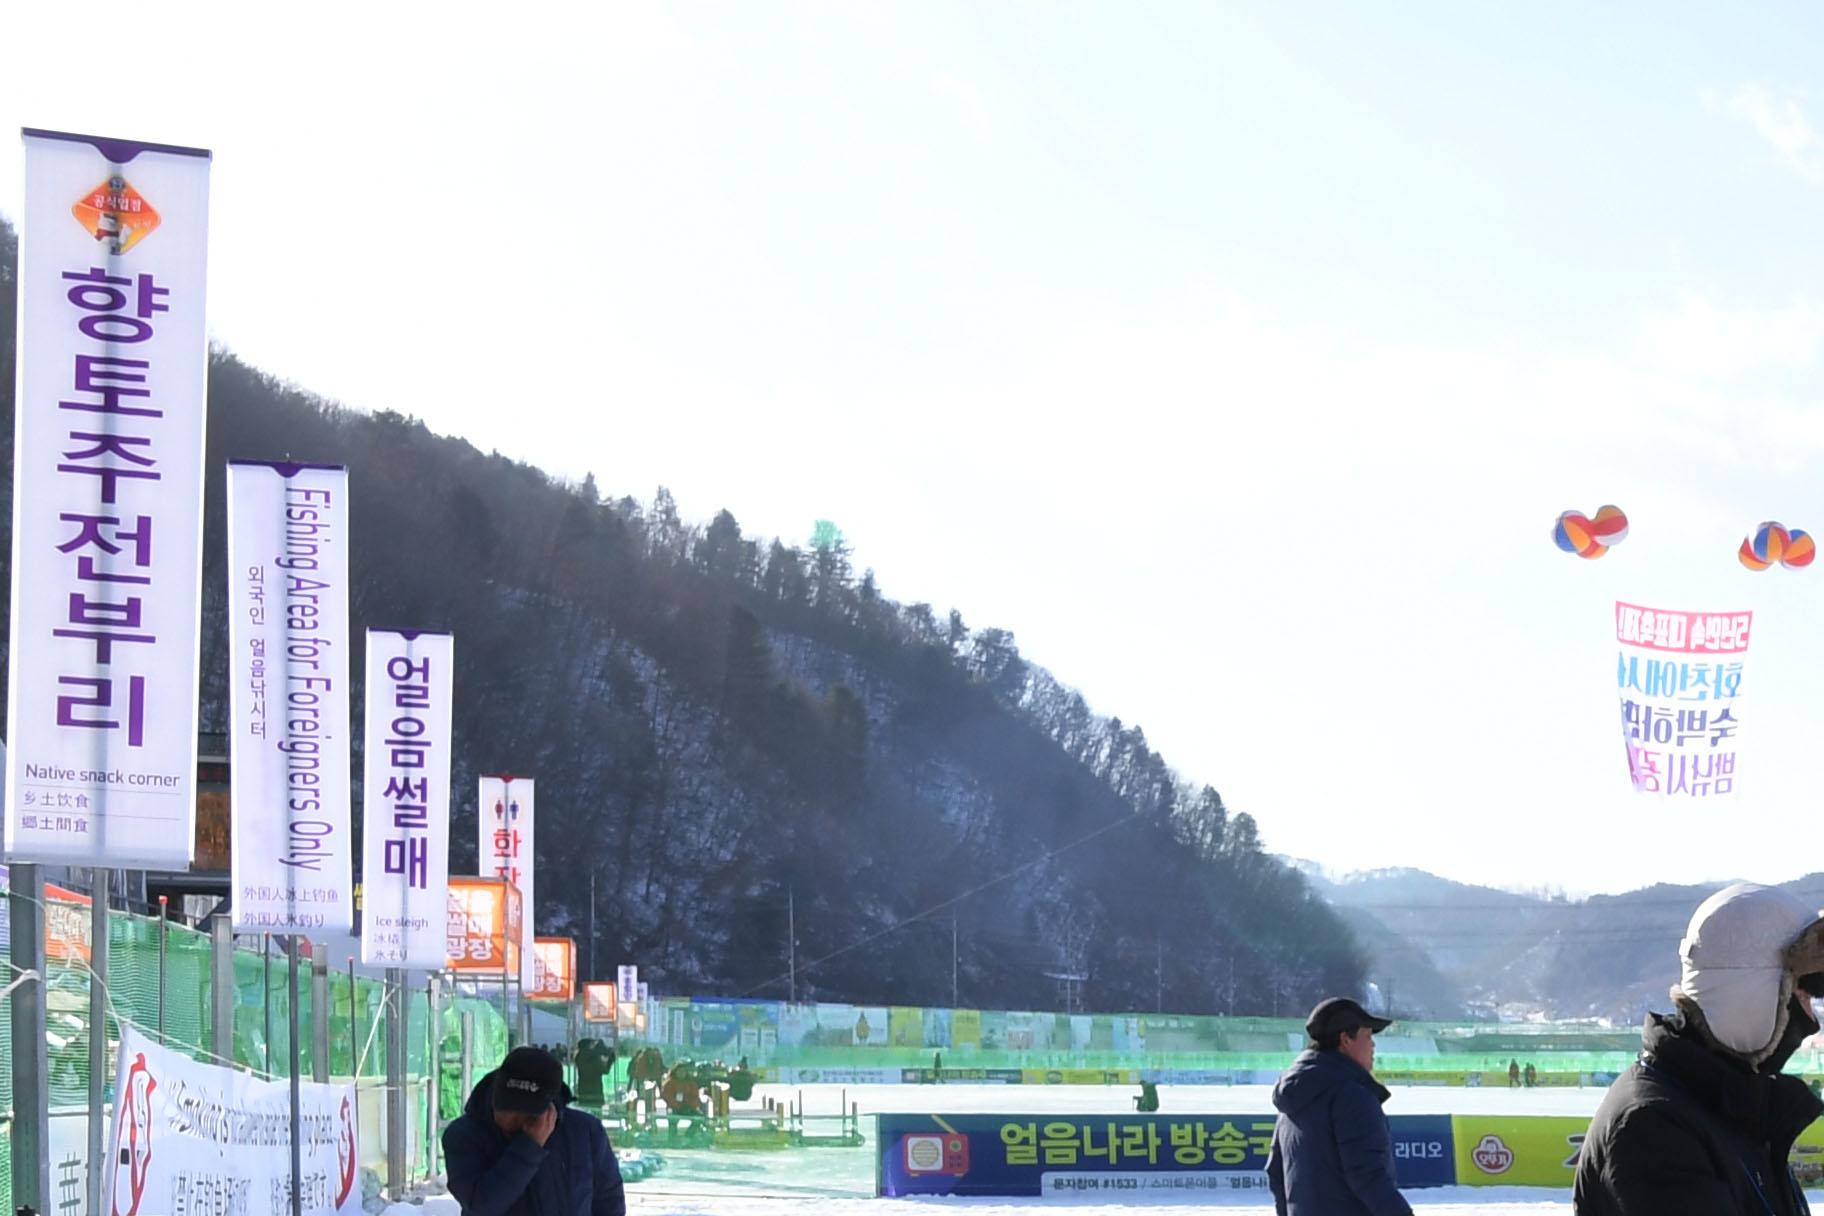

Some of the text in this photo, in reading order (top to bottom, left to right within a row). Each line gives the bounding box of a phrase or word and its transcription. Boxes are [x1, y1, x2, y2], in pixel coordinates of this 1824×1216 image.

[53, 266, 170, 748] 향토주전부리
[247, 565, 267, 740] 외국인 얼음낚시터
[274, 487, 333, 872] Fishing Area for Foreigners Only
[25, 764, 181, 788] Native snack corner
[383, 656, 433, 891] 얼음썰매
[375, 915, 429, 931] Ice sleigh
[1000, 1122, 1163, 1166] 얼음나라
[1394, 1141, 1444, 1160] 라디오
[1052, 1176, 1100, 1192] 문자참여
[1101, 1177, 1138, 1191] #1533
